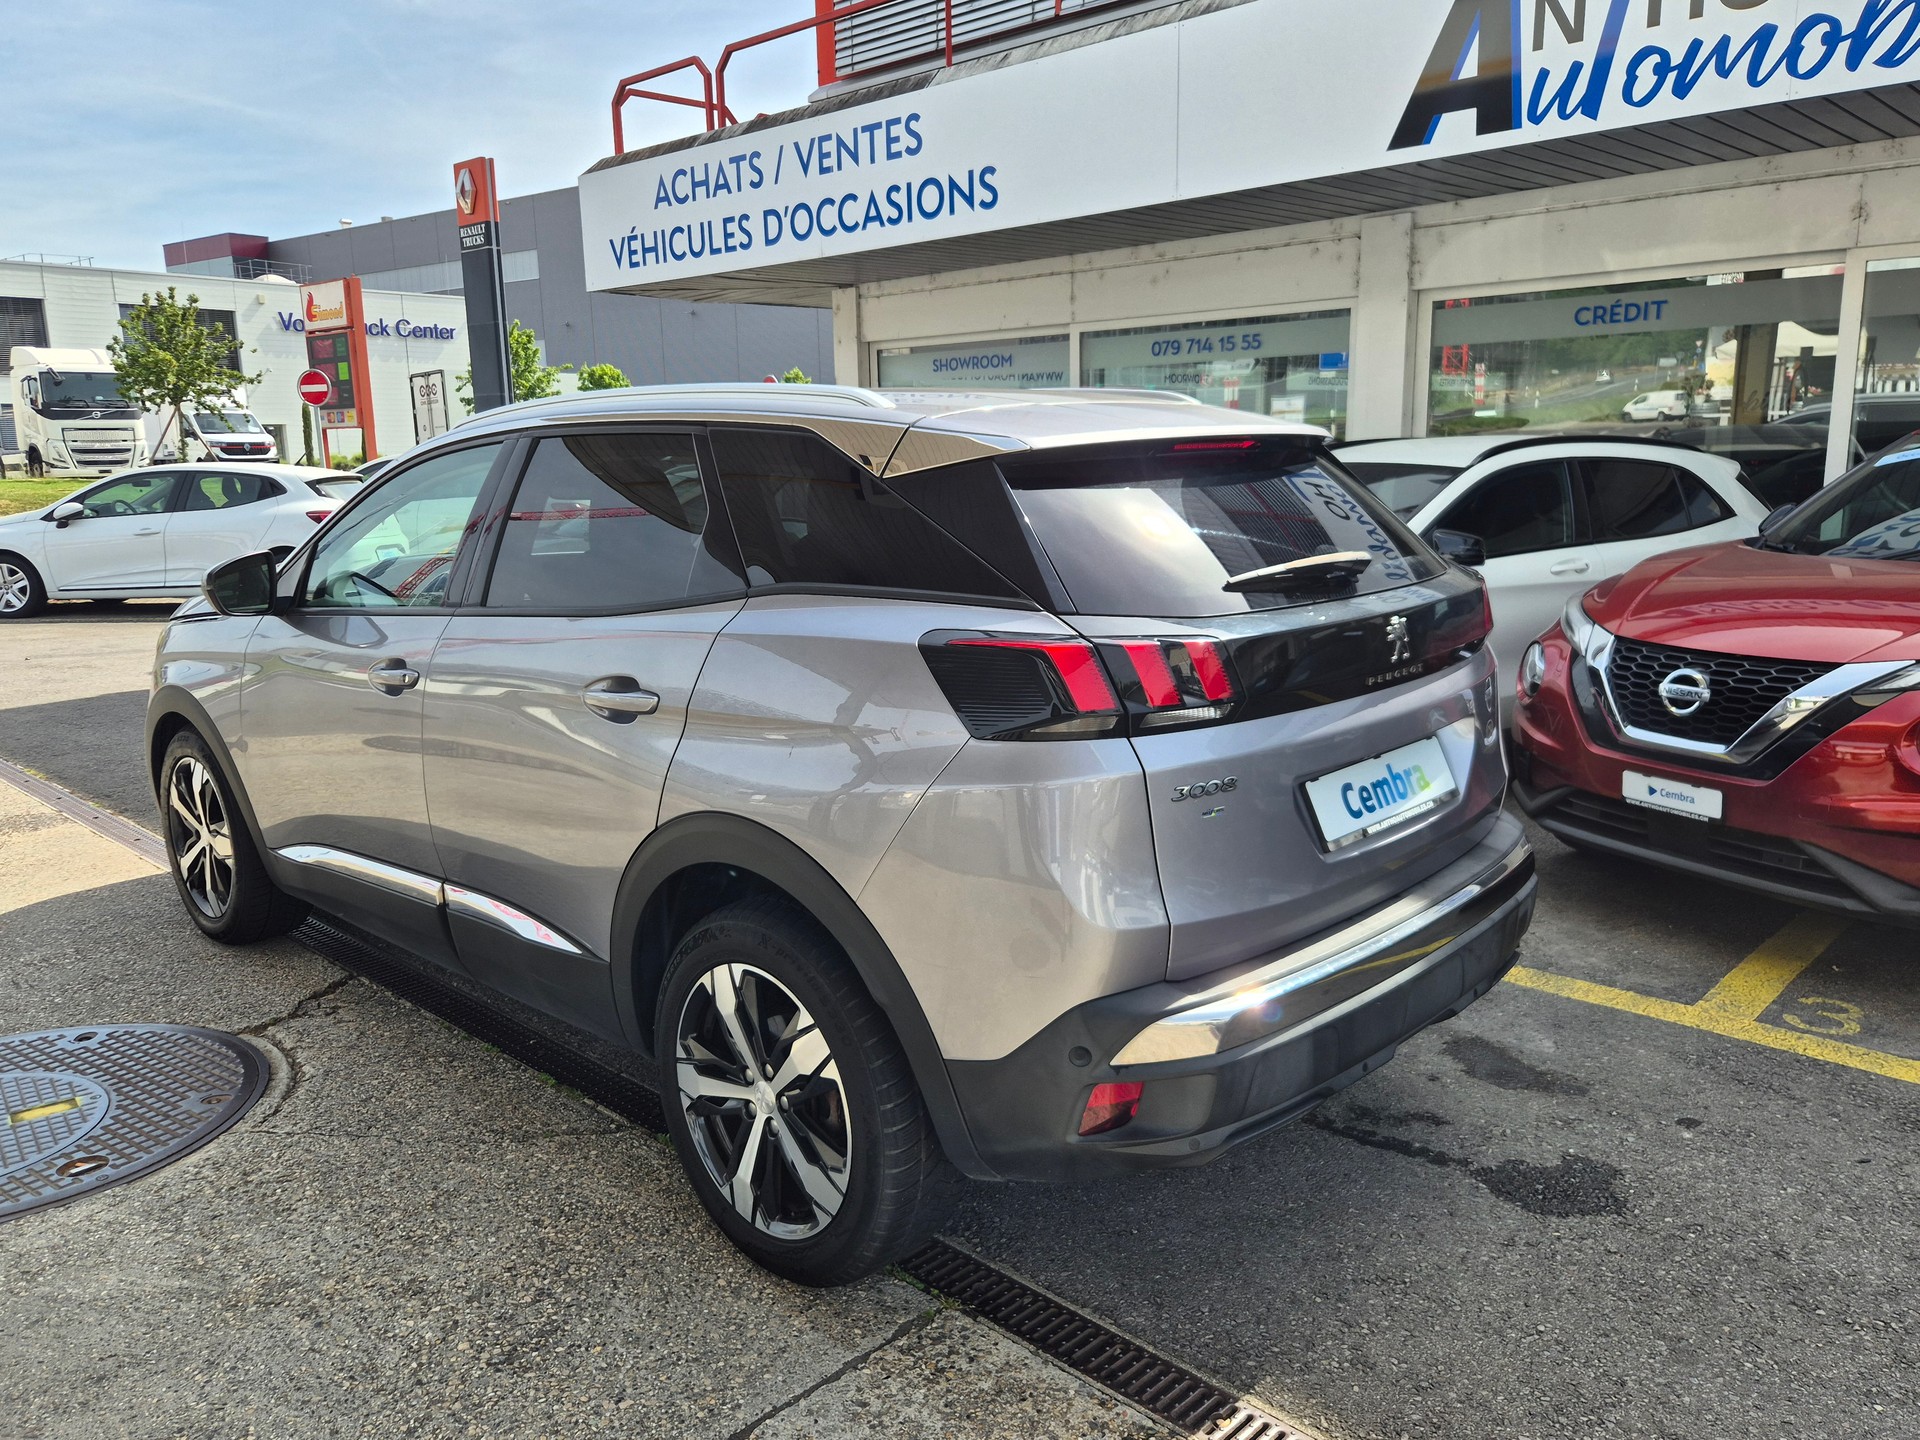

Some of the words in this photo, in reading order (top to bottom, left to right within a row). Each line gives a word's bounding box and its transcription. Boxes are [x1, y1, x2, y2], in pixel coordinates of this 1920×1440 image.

[653, 150, 765, 210] ACHATS
[793, 112, 923, 178] VENTES
[609, 213, 753, 271] VÉHICULES
[763, 165, 1000, 247] D'OCCASIONS
[460, 223, 485, 238] RENAULT
[462, 234, 485, 247] TRUCKS
[1574, 299, 1669, 326] CRÉDIT
[395, 318, 456, 340] Center
[1151, 337, 1181, 357] 079
[1186, 335, 1213, 355] 714
[1219, 334, 1236, 353] 15
[1240, 332, 1262, 351] 55
[932, 353, 1013, 373] SHOWROOM
[1368, 663, 1424, 686] PEUGEOT
[1662, 687, 1703, 699] NISSAN
[1170, 776, 1238, 802] 3008
[1340, 763, 1431, 820] Cembra
[1660, 788, 1696, 804] Cembra
[1782, 995, 1865, 1036] 3
